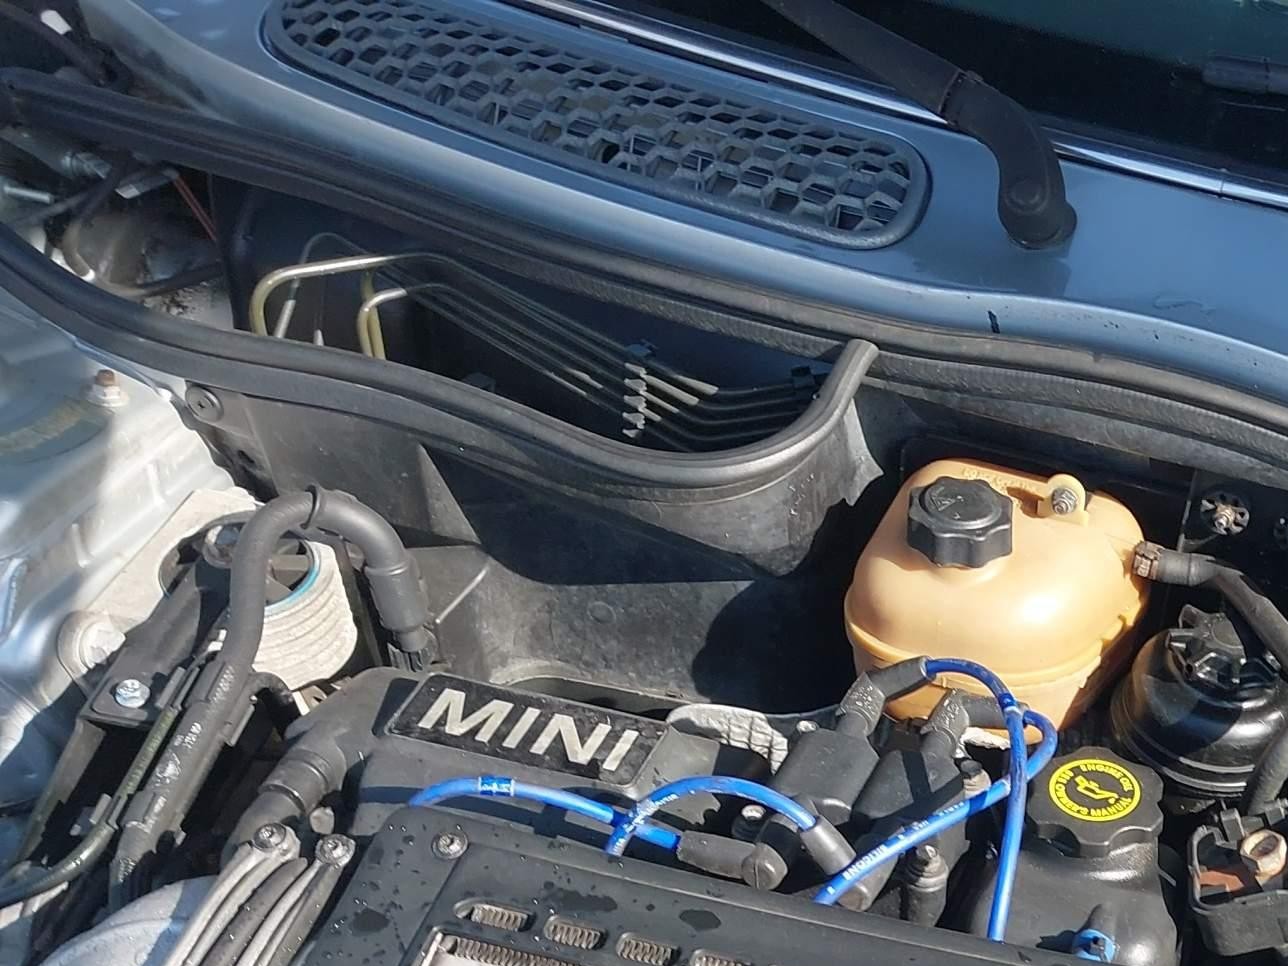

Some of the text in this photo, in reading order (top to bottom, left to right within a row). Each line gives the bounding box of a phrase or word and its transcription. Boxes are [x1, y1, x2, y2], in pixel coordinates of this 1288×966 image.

[417, 687, 640, 772] MINI
[1080, 764, 1121, 779] ENGINE
[1090, 798, 1132, 817] MANUAL
